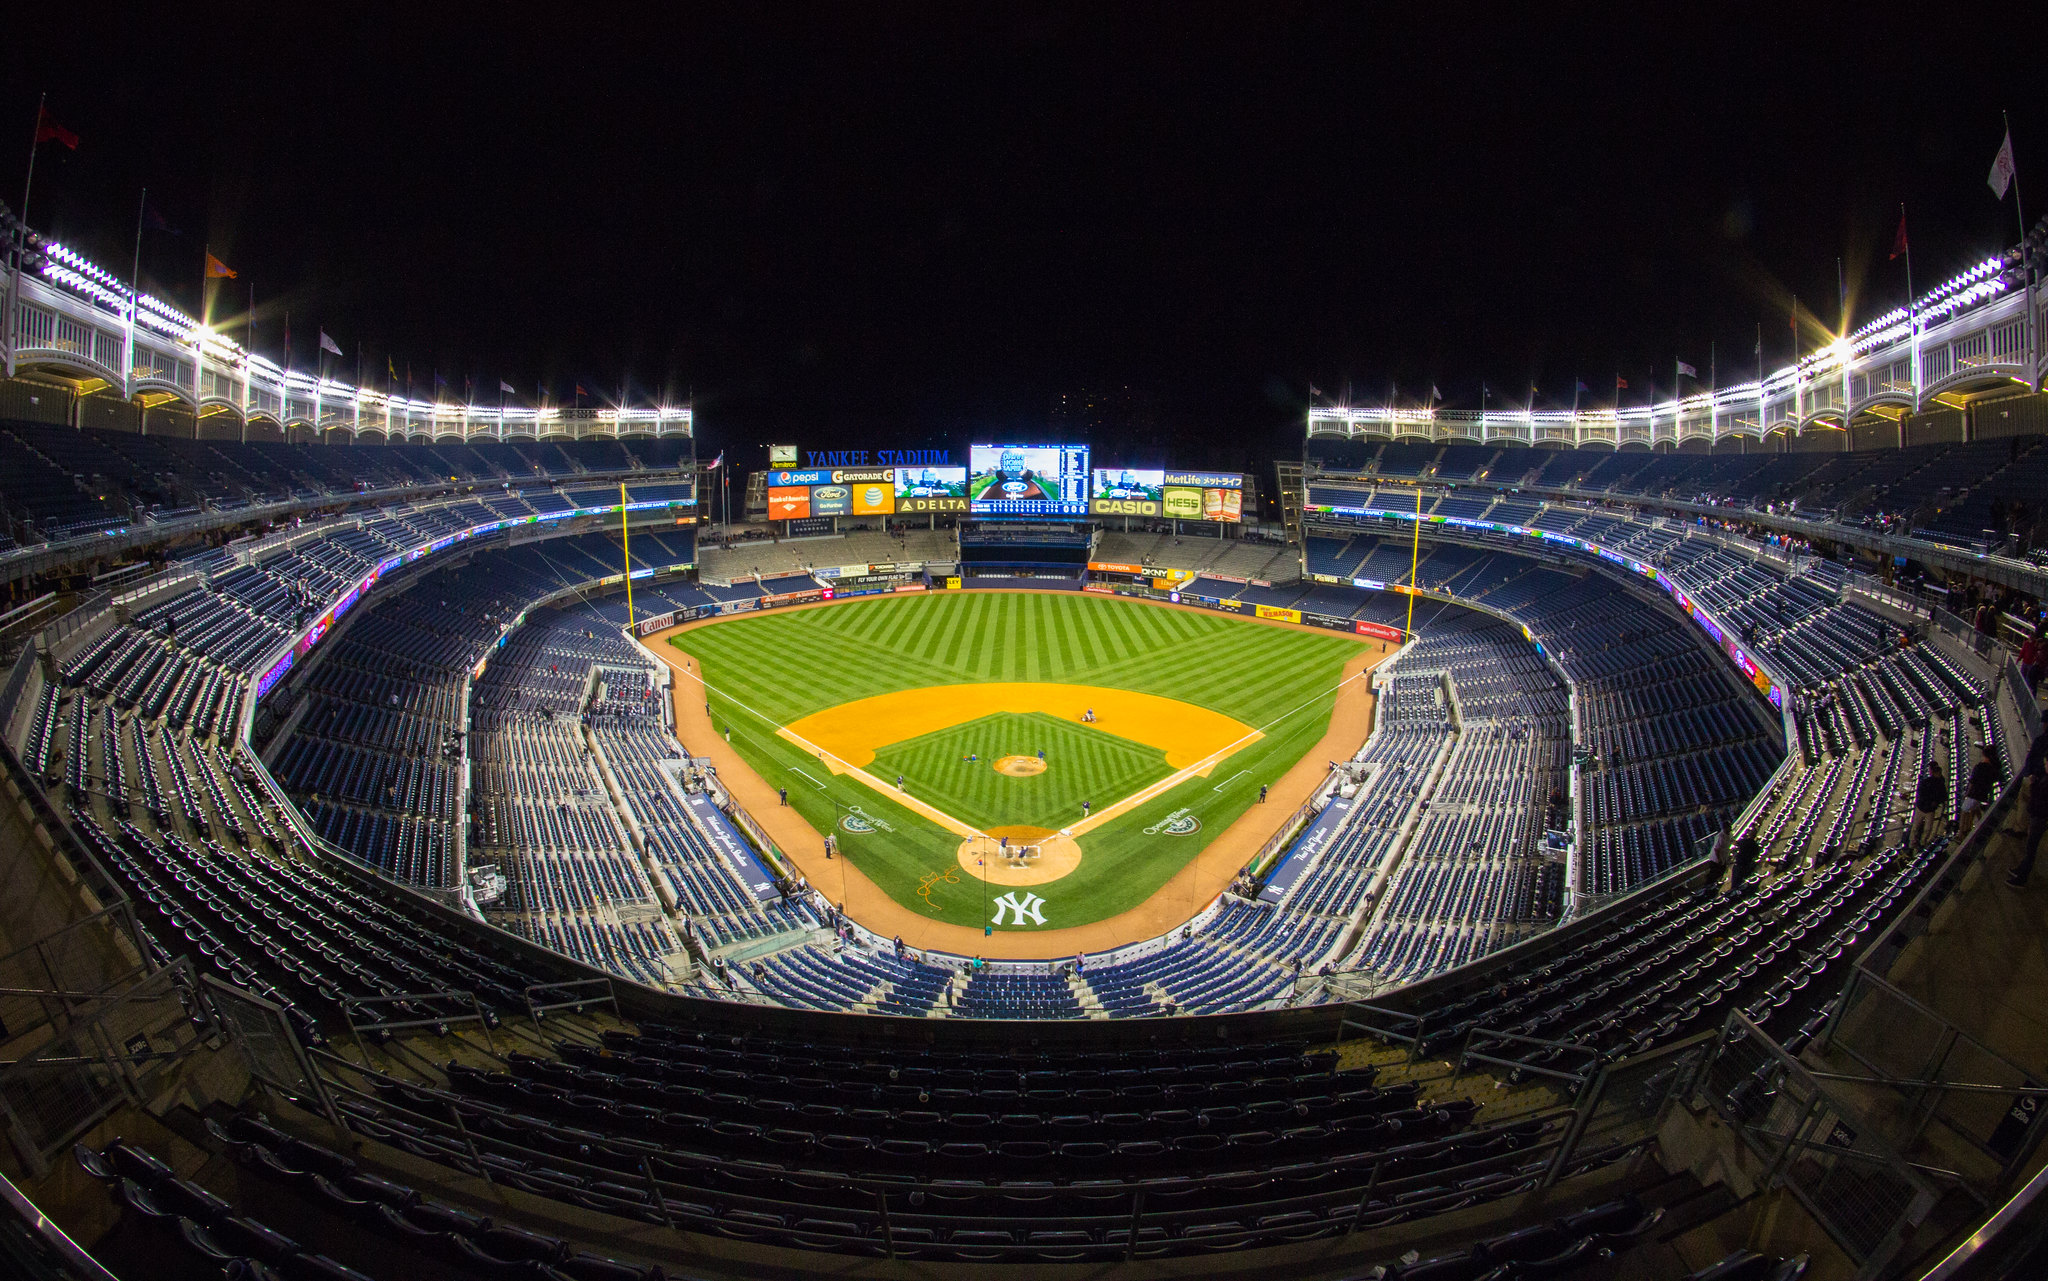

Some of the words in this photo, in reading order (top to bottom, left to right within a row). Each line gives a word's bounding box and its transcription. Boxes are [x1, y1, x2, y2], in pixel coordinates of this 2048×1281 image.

[806, 450, 870, 467] YANKEE
[877, 450, 949, 466] STADIUM
[793, 472, 819, 484] pepsi
[832, 470, 844, 484] G
[844, 472, 882, 481] GATORADE
[883, 469, 894, 482] G
[1165, 474, 1201, 485] MetLife
[820, 490, 842, 498] Ford
[917, 500, 967, 510] DELTA
[1095, 500, 1156, 515] CASIO
[1167, 498, 1199, 508] HESS
[1141, 567, 1168, 577] DKNY
[641, 615, 674, 634] Canon
[991, 891, 1049, 927] NY
